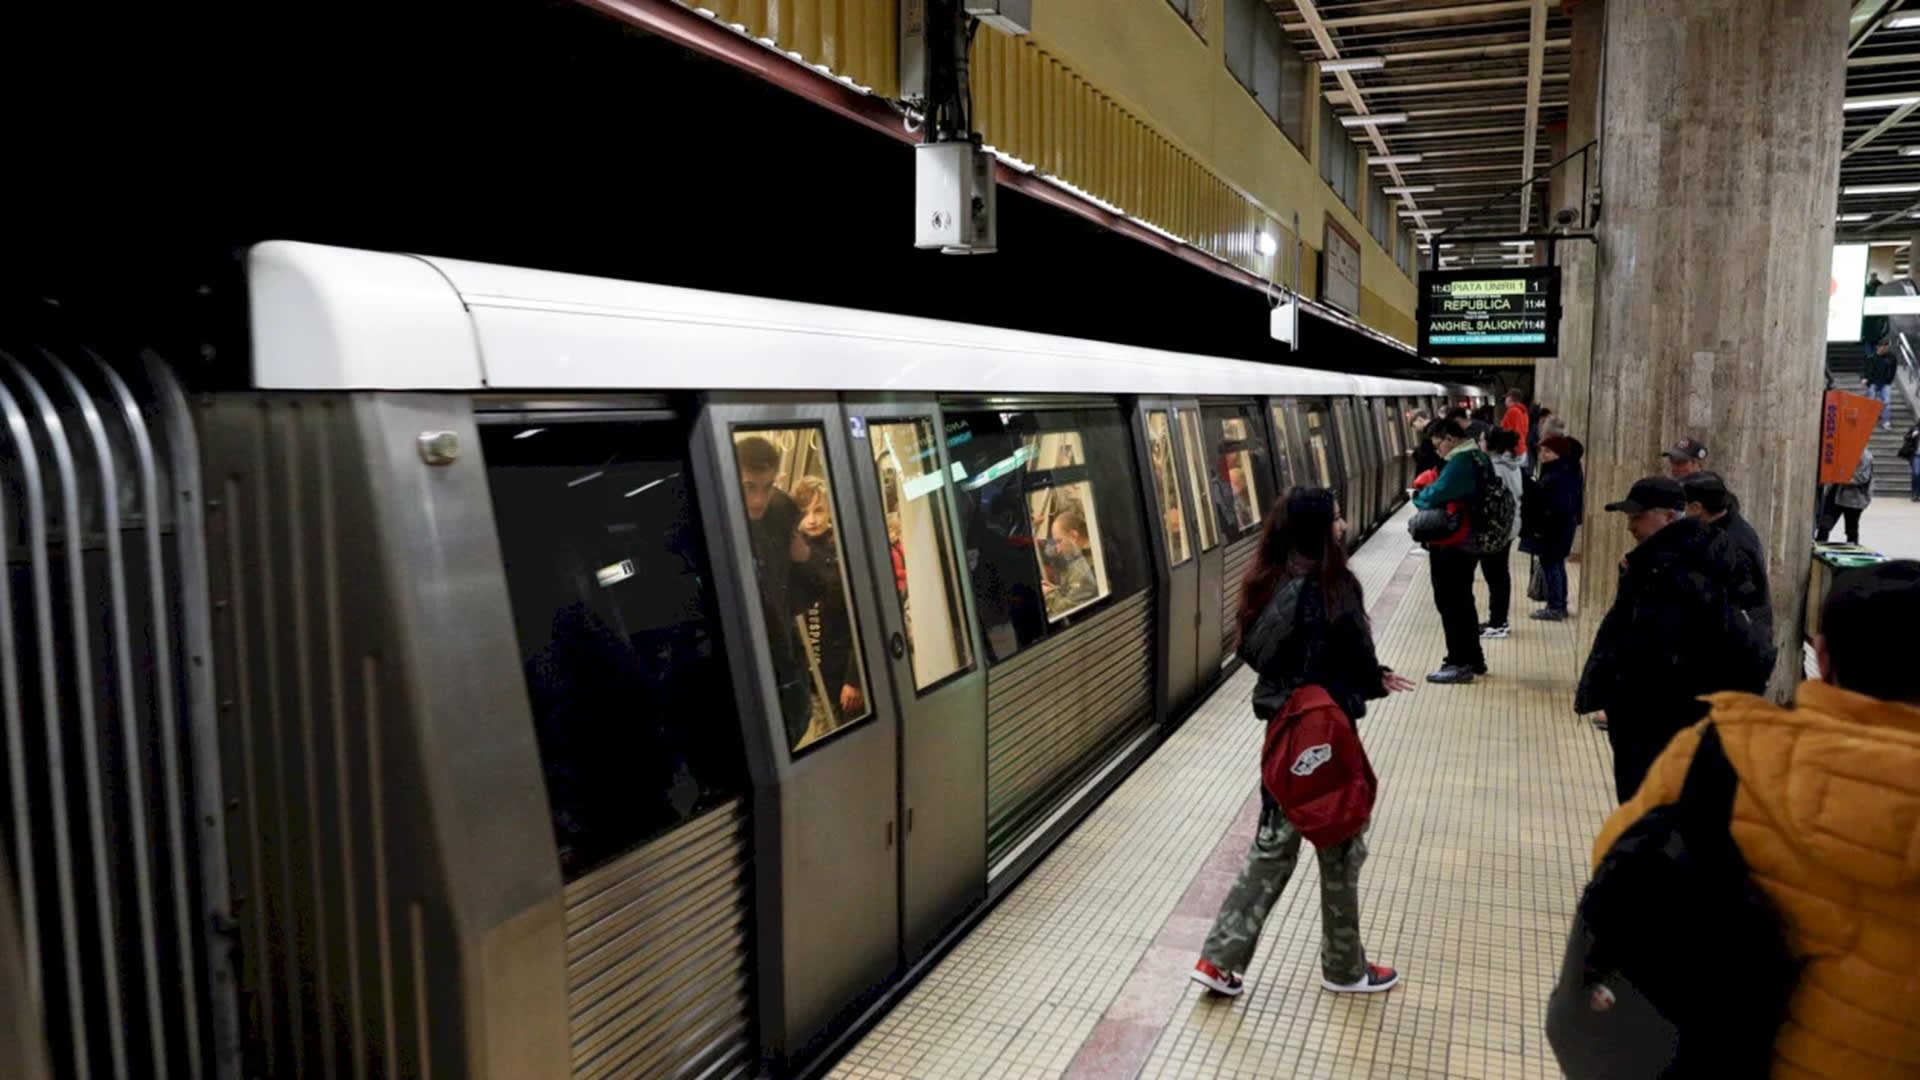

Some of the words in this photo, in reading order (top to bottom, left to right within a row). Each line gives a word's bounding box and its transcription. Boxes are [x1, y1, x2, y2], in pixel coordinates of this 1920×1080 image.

[1534, 282, 1539, 290] 1
[1444, 299, 1511, 310] REPUBLICA
[1525, 300, 1546, 309] 11:44
[1430, 321, 1474, 331] ANGHEL
[1476, 319, 1523, 330] SALIGNY
